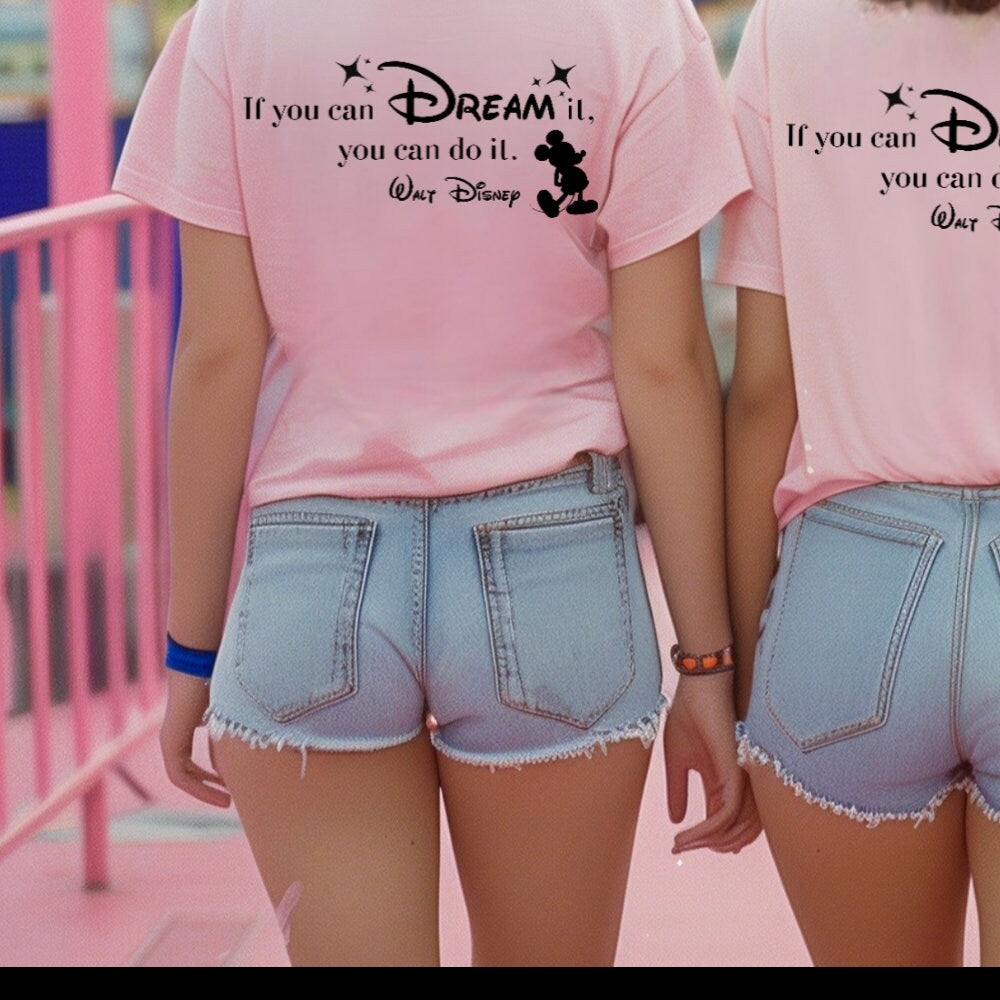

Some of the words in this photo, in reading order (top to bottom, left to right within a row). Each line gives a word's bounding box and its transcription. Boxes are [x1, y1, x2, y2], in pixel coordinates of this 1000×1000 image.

[243, 96, 266, 121] If
[271, 104, 319, 129] you
[327, 104, 374, 121] can
[567, 97, 595, 125] it,
[337, 143, 385, 168] you
[393, 143, 440, 161] can
[448, 136, 482, 161] do
[490, 137, 518, 161] it.
[786, 123, 809, 148] If
[814, 131, 862, 156] you
[870, 131, 917, 149] can
[879, 172, 928, 196] you
[936, 171, 982, 189] can
